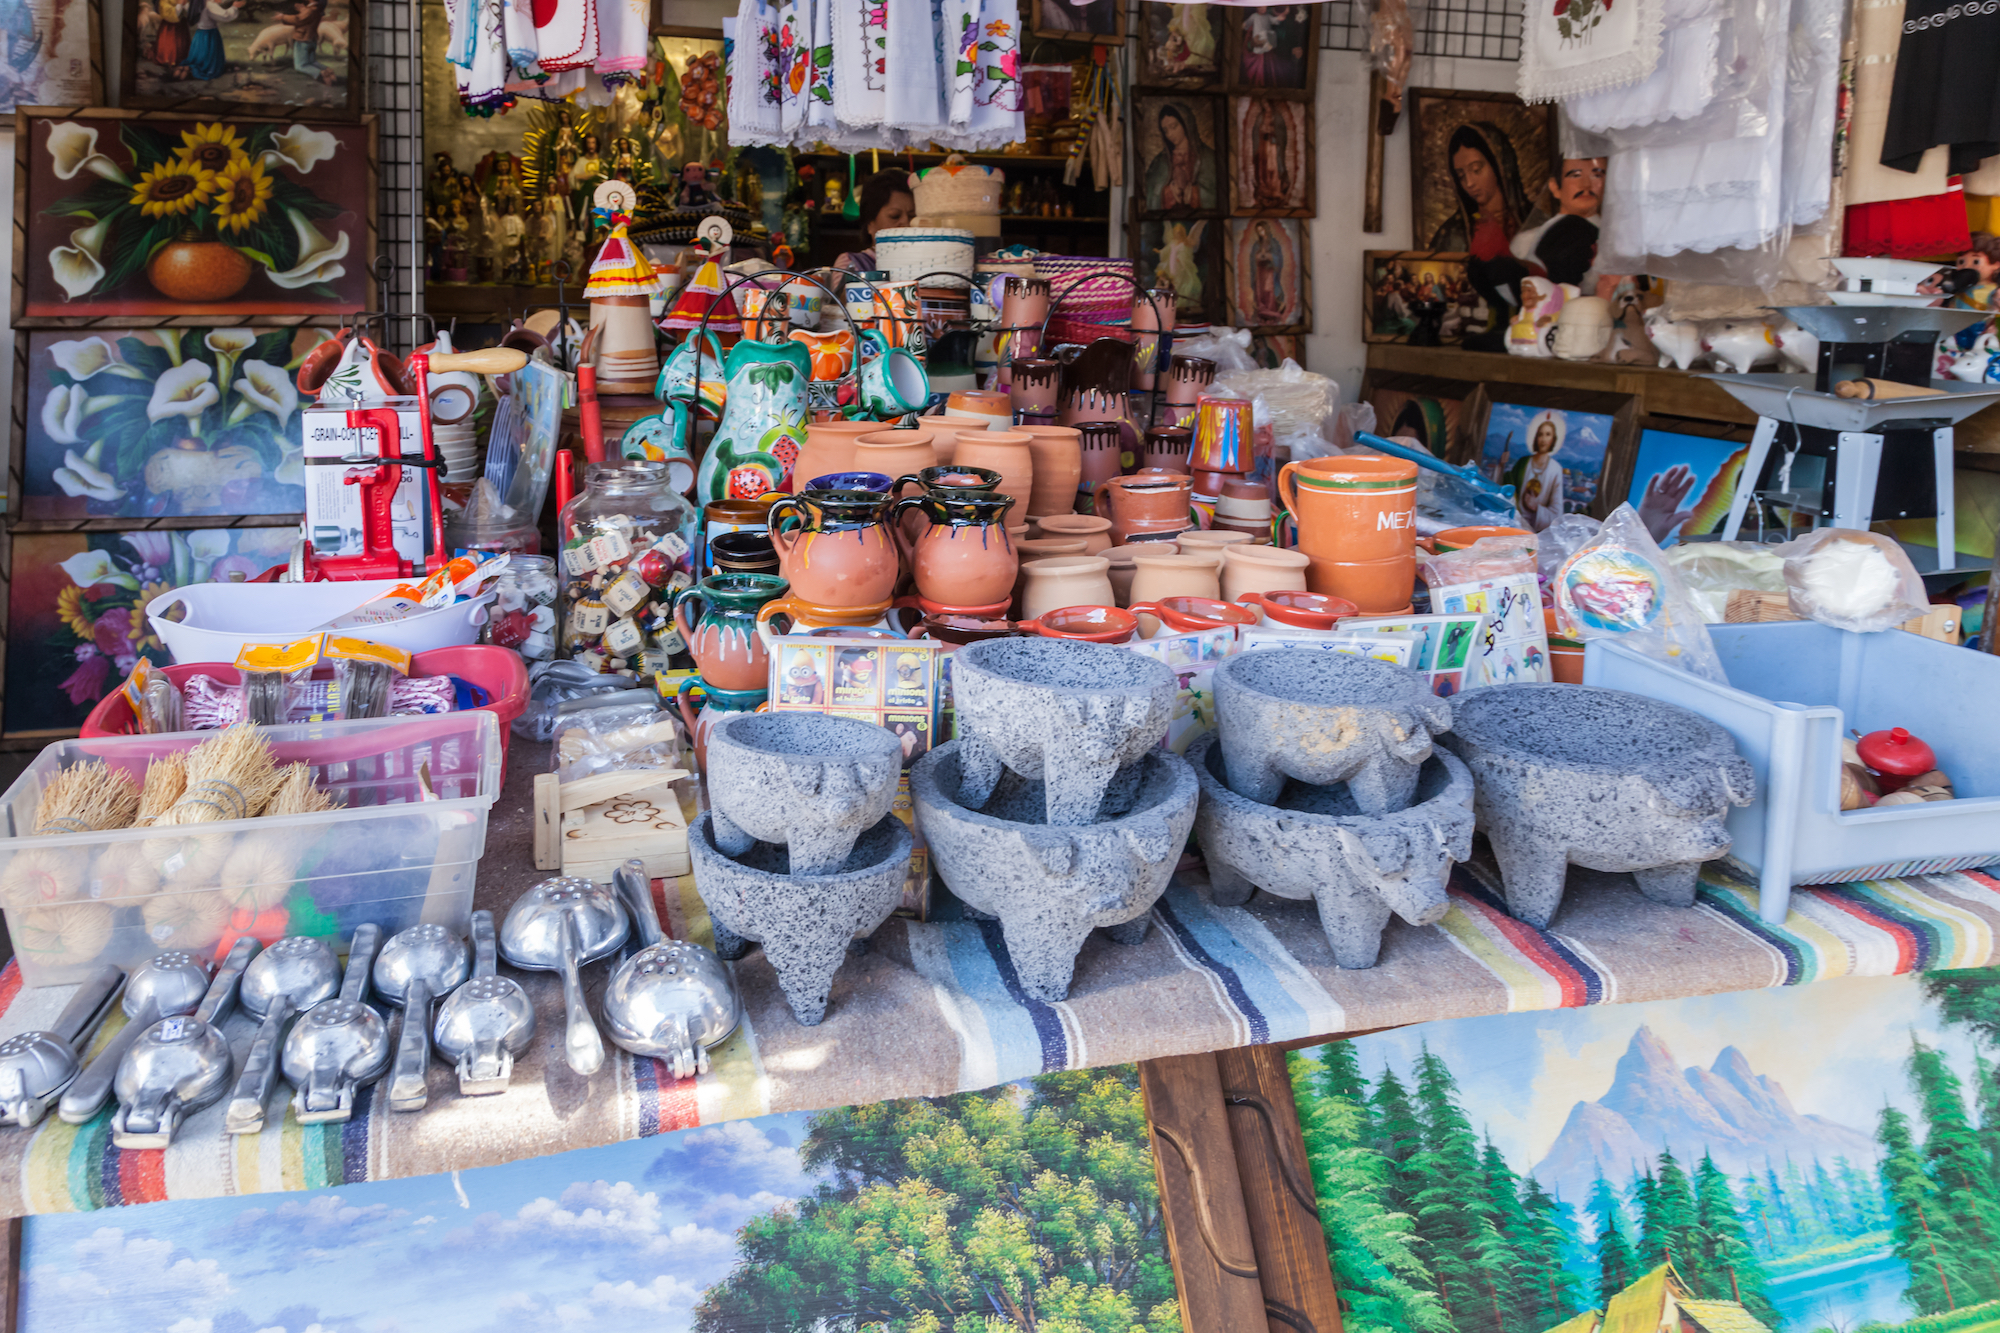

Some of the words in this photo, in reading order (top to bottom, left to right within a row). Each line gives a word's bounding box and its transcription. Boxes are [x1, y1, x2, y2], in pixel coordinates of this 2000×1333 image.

[583, 545, 595, 563] TOMA
[618, 588, 633, 603] TOMA
[835, 686, 874, 695] minions
[888, 688, 927, 697] minions
[888, 714, 926, 723] minions
